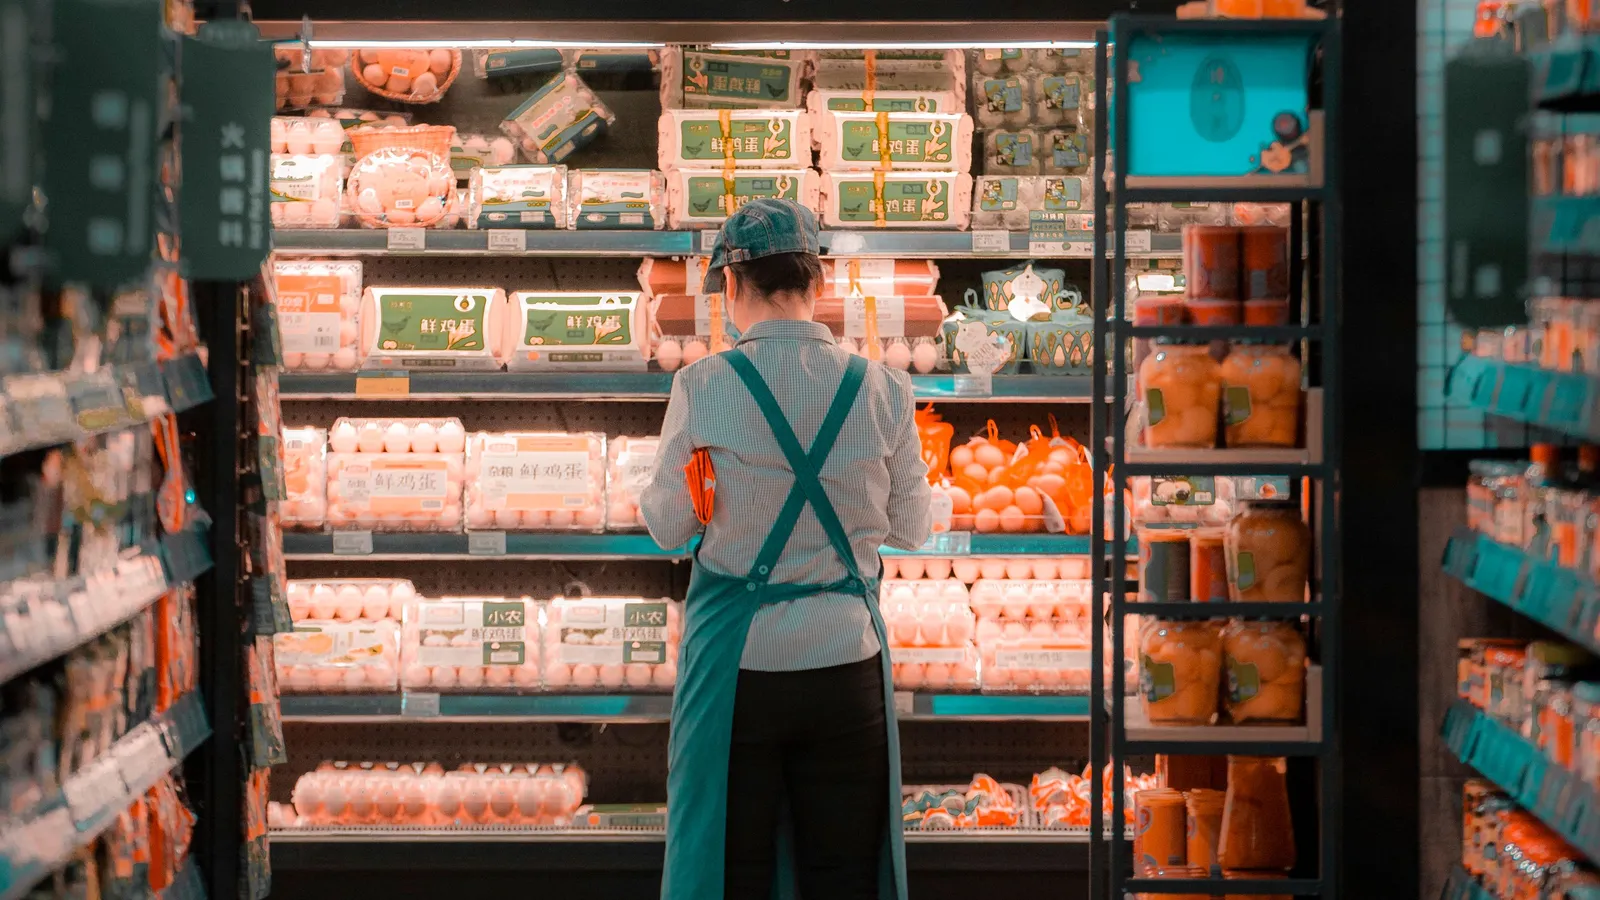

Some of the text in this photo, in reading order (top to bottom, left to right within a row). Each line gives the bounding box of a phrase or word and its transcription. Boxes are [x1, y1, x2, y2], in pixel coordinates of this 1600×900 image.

[420, 318, 476, 334] 鲜鸡蛋
[566, 315, 621, 329] 鲜鸡蛋
[519, 463, 584, 480] 鲜鸡蛋
[374, 472, 437, 491] 鲜鸡蛋
[488, 610, 522, 624] 小农
[630, 611, 663, 624] 小农
